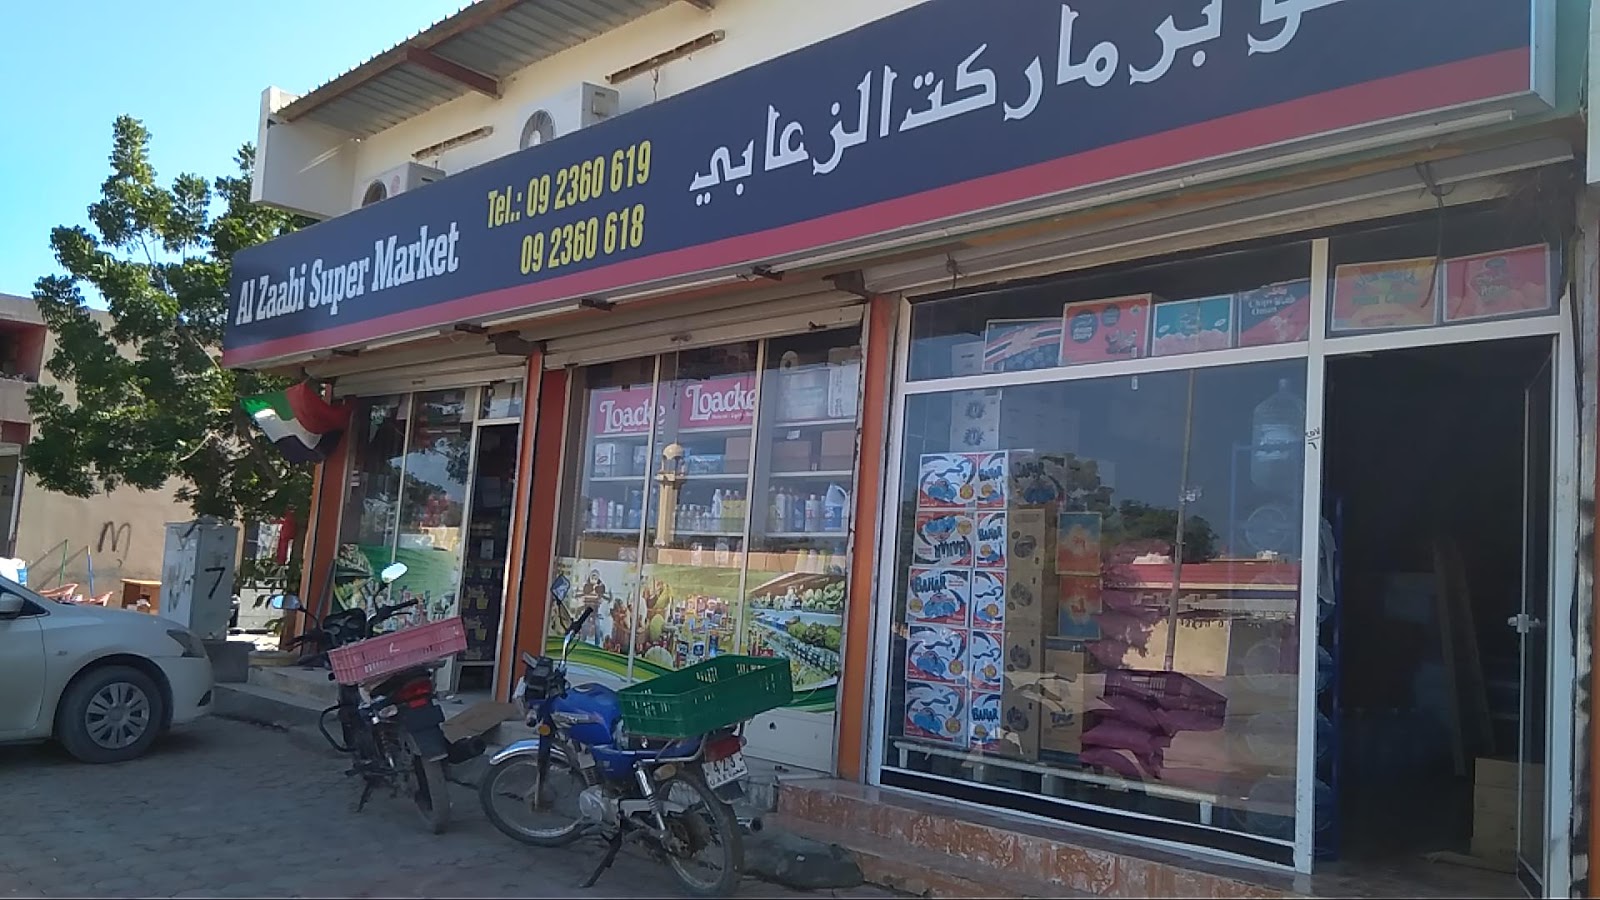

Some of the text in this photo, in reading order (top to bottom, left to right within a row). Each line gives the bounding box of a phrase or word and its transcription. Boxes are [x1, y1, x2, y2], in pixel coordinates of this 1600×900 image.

[689, 0, 1345, 207] وبر ماركت الزعابي
[487, 140, 652, 229] Tel.: 09 2360 619
[235, 221, 460, 325] Al Zaabi Super Market
[520, 203, 645, 275] 09 2360 618
[914, 575, 947, 594] BAHAR
[971, 707, 999, 722] BAHAR
